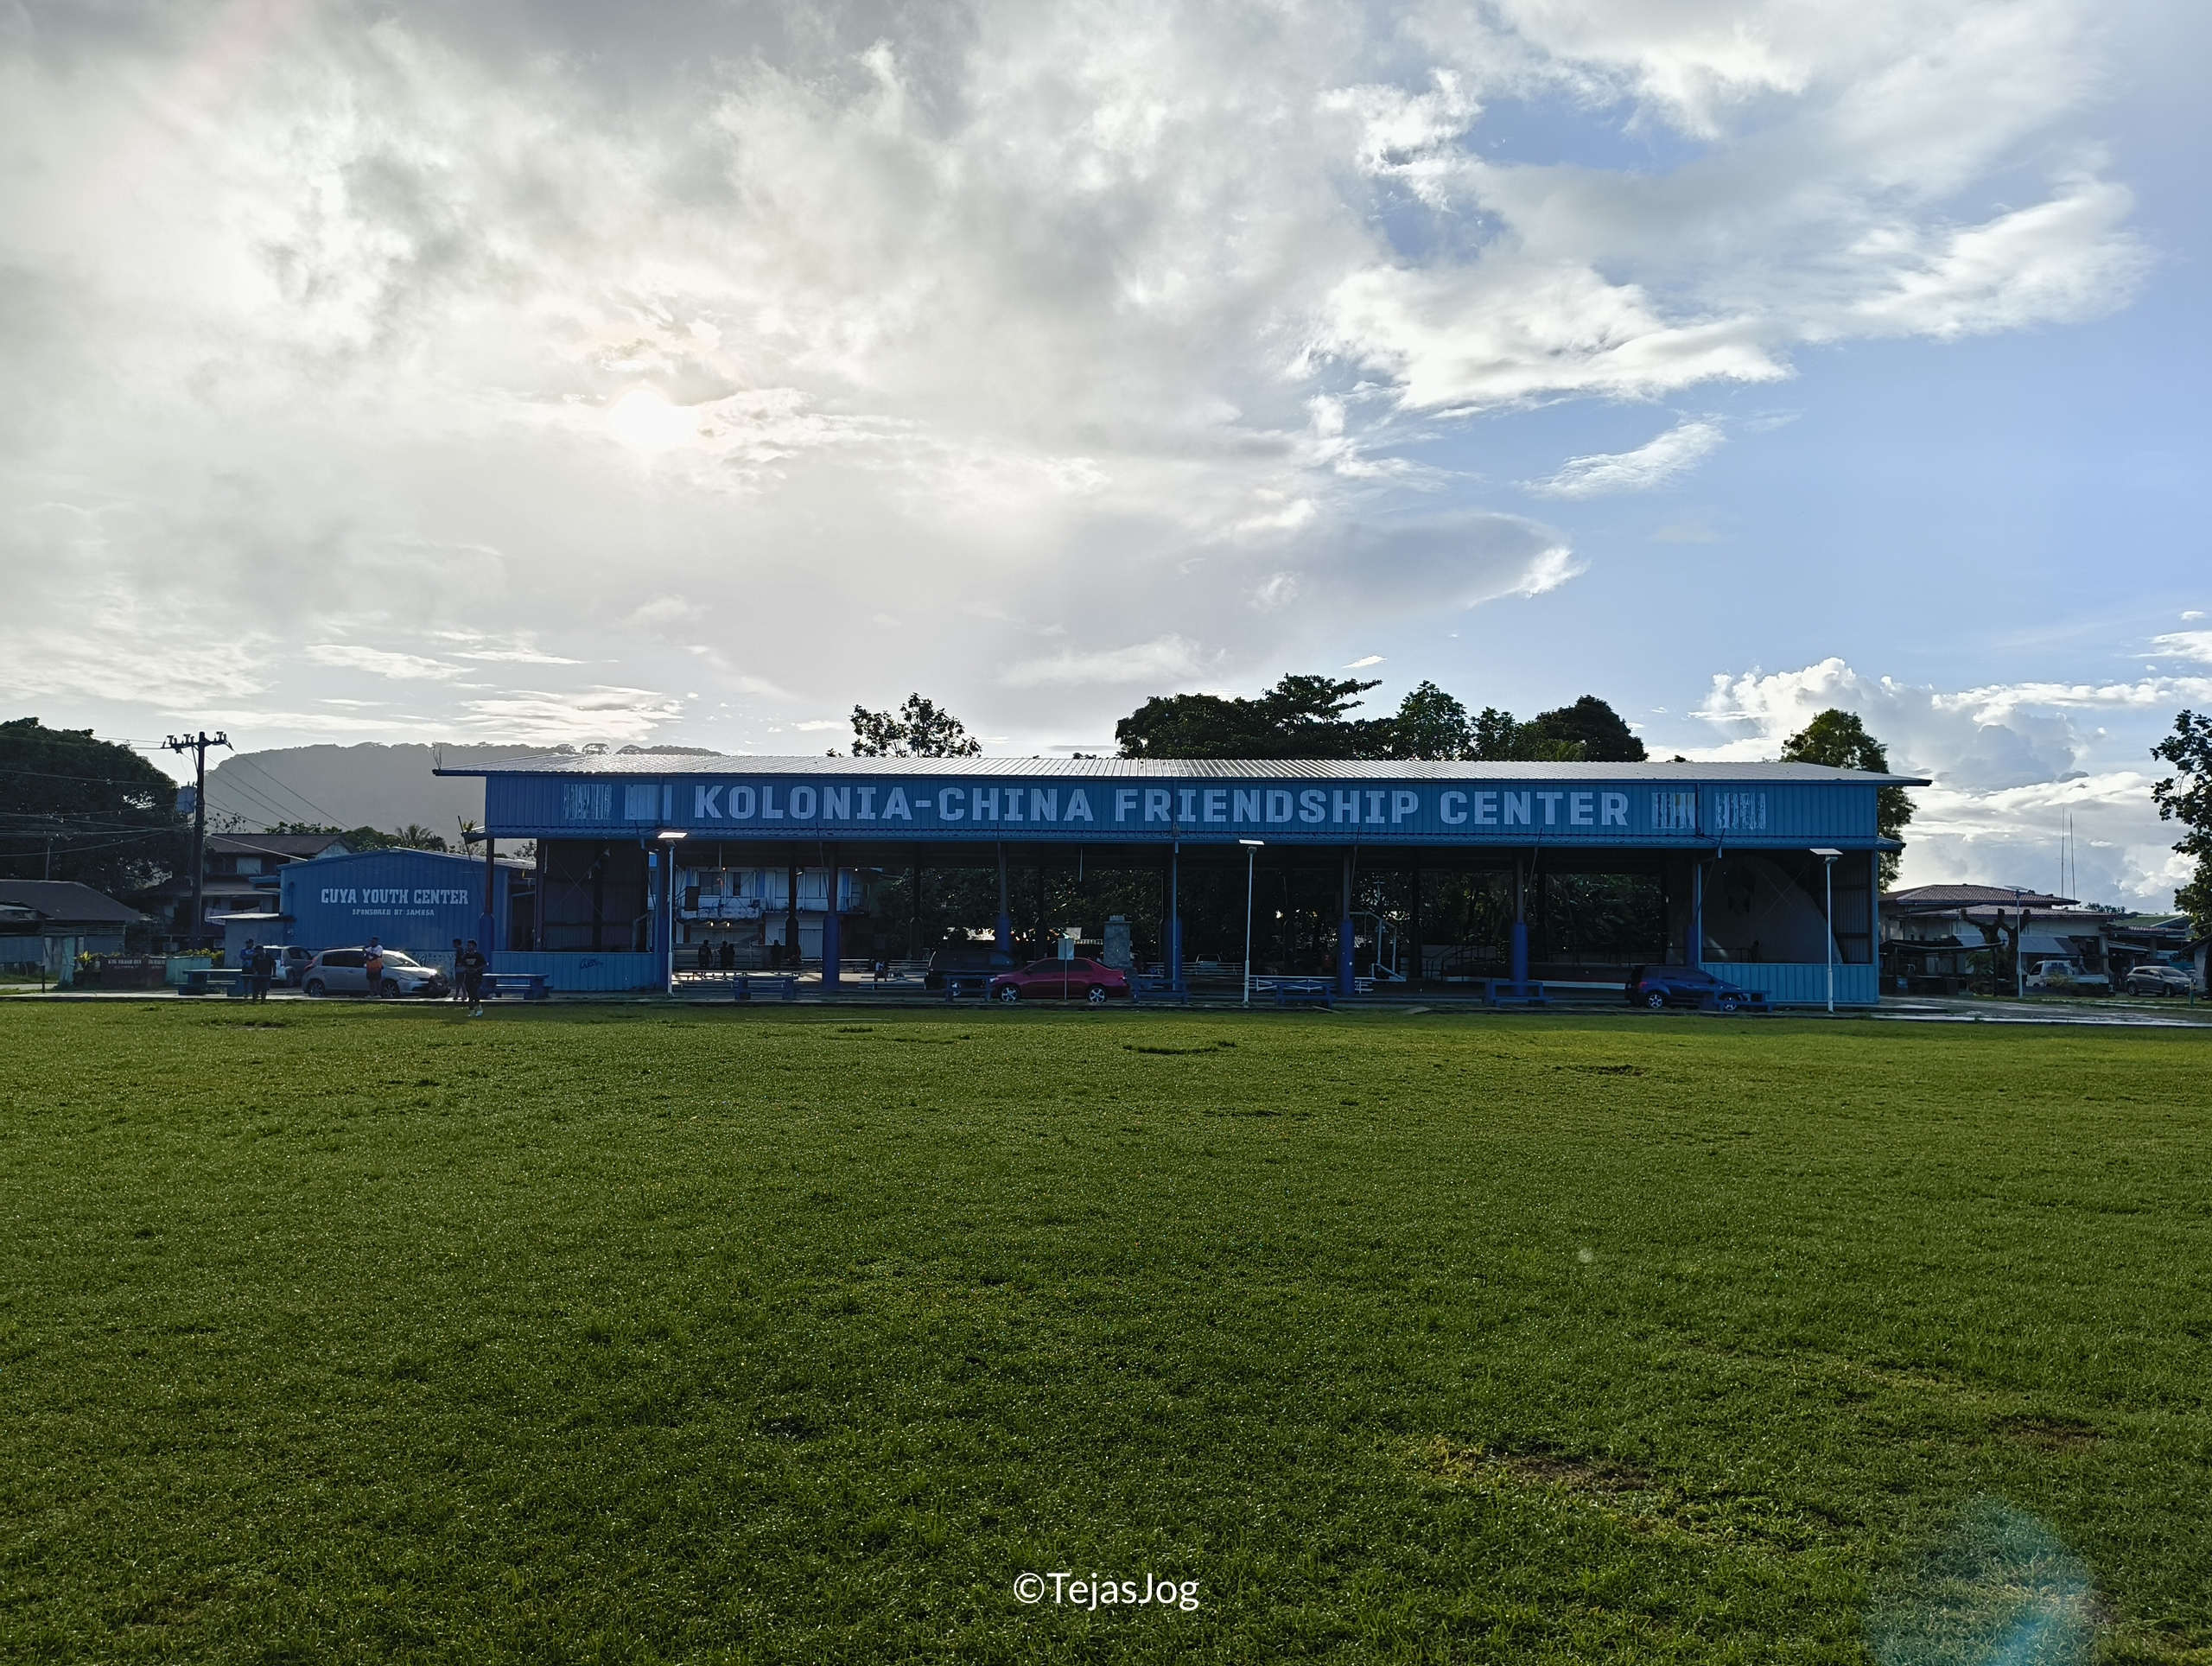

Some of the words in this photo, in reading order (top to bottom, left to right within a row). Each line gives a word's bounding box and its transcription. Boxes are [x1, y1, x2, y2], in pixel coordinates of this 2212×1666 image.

[694, 785, 1095, 822] KOLONIA-CHINA
[1115, 788, 1420, 824] FRIENDSHIP
[1440, 790, 1629, 826] CENTER
[321, 888, 357, 904] CUYA
[362, 888, 409, 904] YOUTH
[413, 889, 468, 905] CENTER
